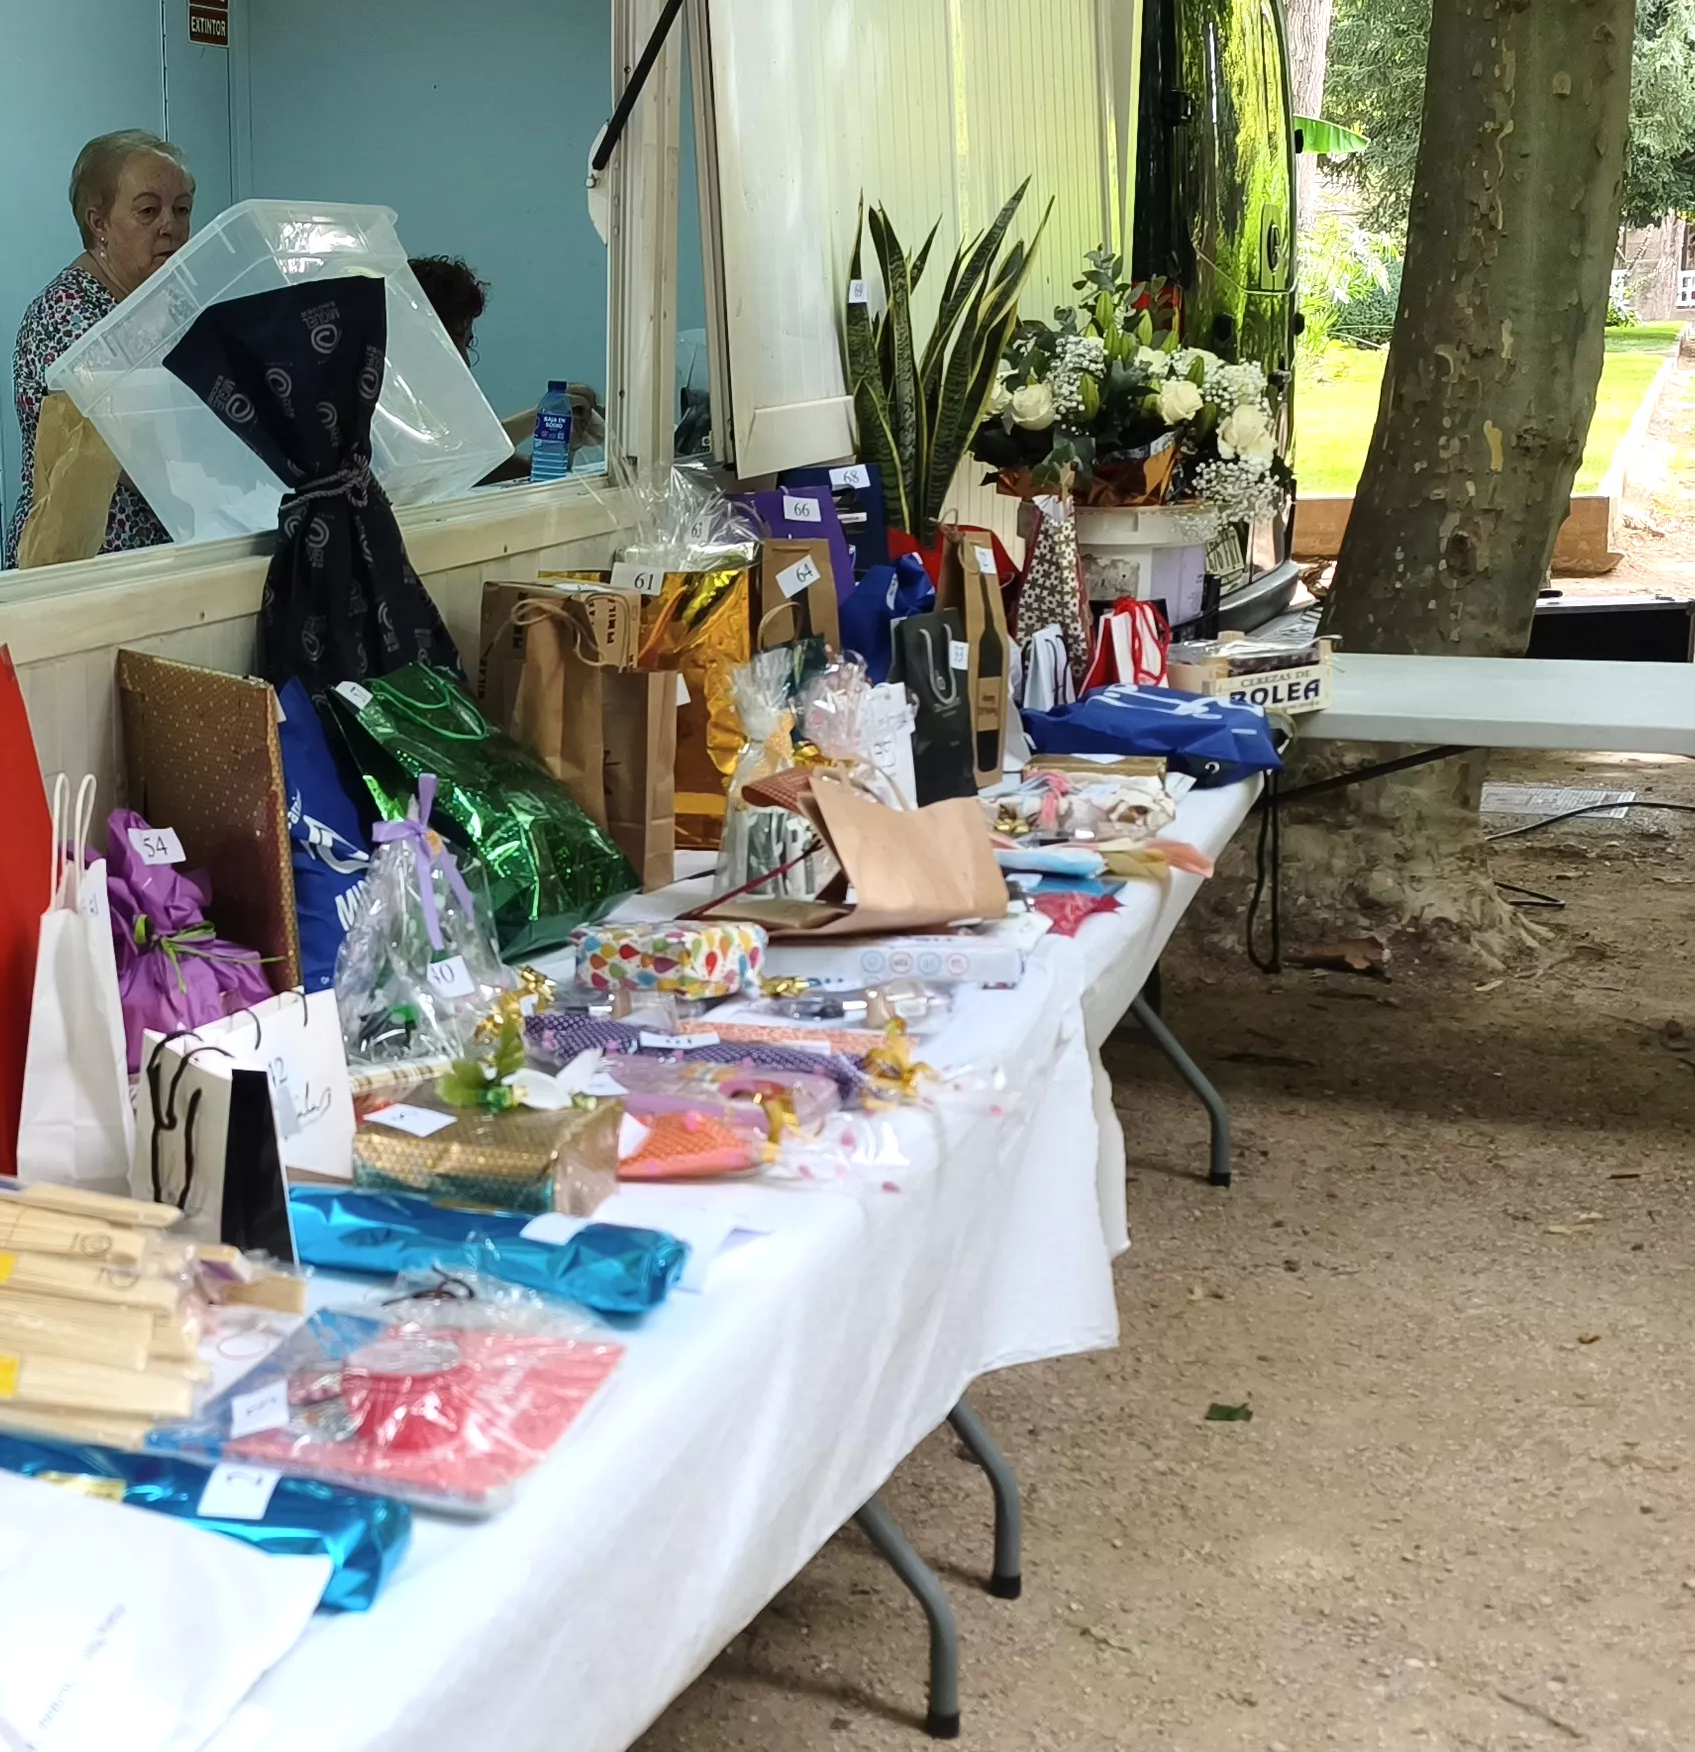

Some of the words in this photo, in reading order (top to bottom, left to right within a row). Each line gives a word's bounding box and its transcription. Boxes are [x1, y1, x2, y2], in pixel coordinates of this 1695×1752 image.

[191, 16, 226, 37] EXTINTOR
[843, 470, 860, 485] 68
[794, 503, 811, 518] 66
[634, 573, 655, 591] 61
[796, 563, 814, 583] 64
[142, 836, 168, 859] 54
